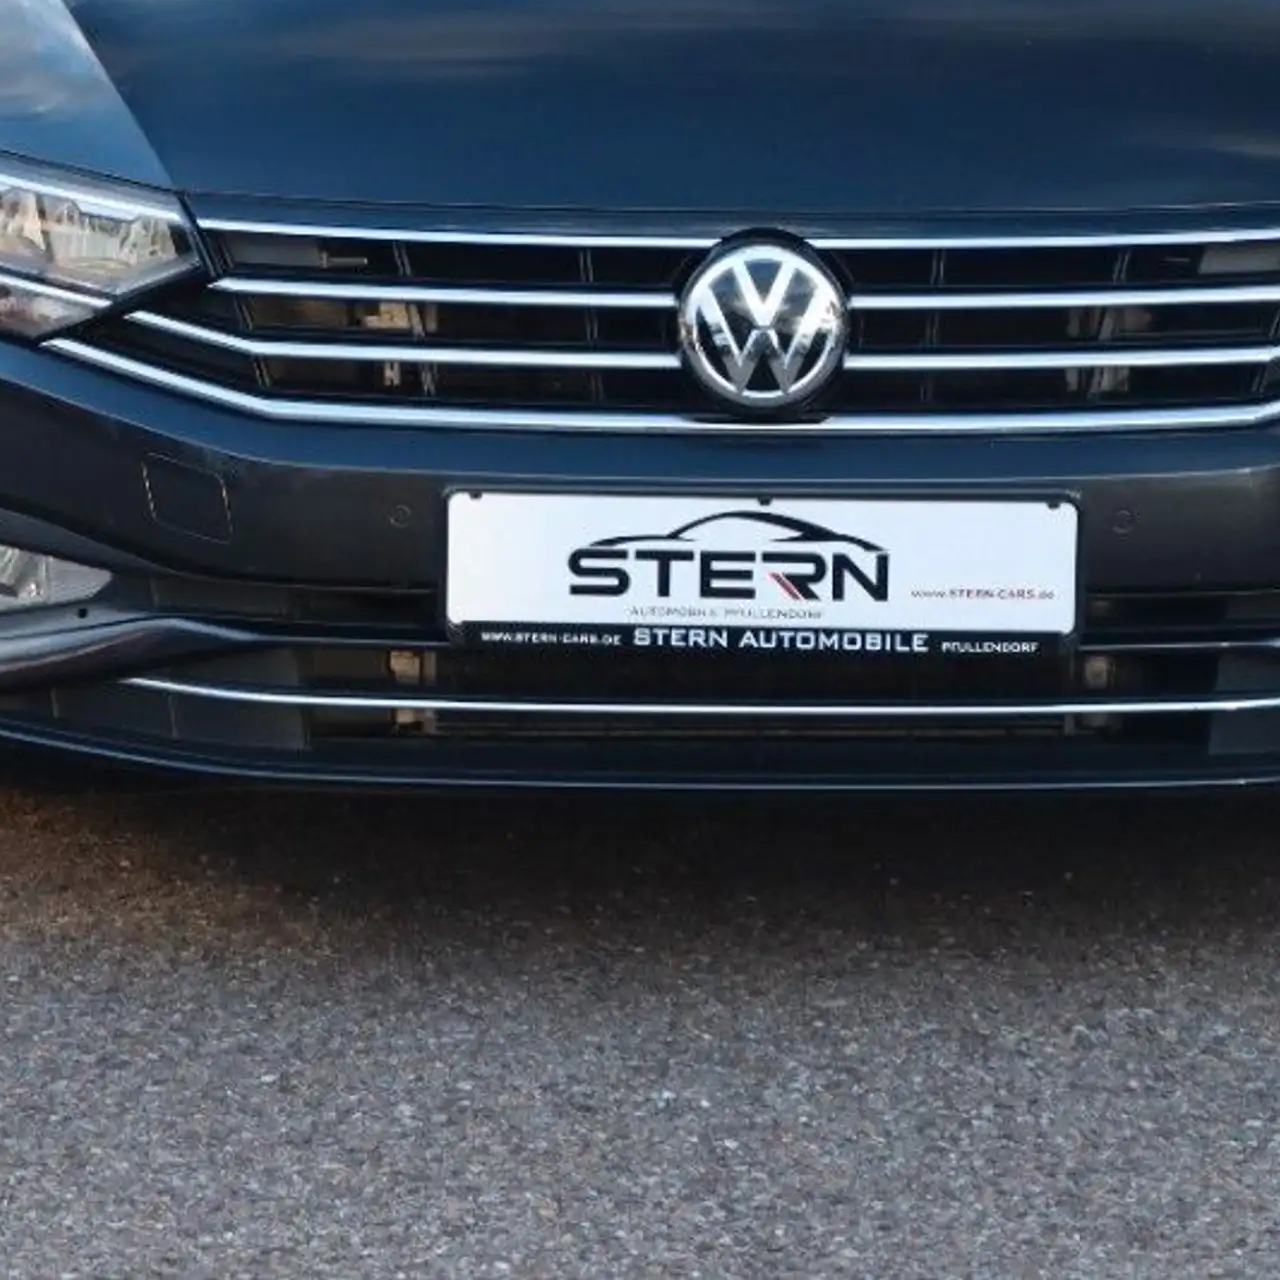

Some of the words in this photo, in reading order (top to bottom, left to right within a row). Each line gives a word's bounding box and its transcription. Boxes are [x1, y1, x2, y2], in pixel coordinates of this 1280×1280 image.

[567, 548, 890, 602] STERN
[632, 627, 729, 648] STERN
[738, 628, 930, 653] AUTOMOBILE
[941, 640, 1040, 654] PFULLENDORF
